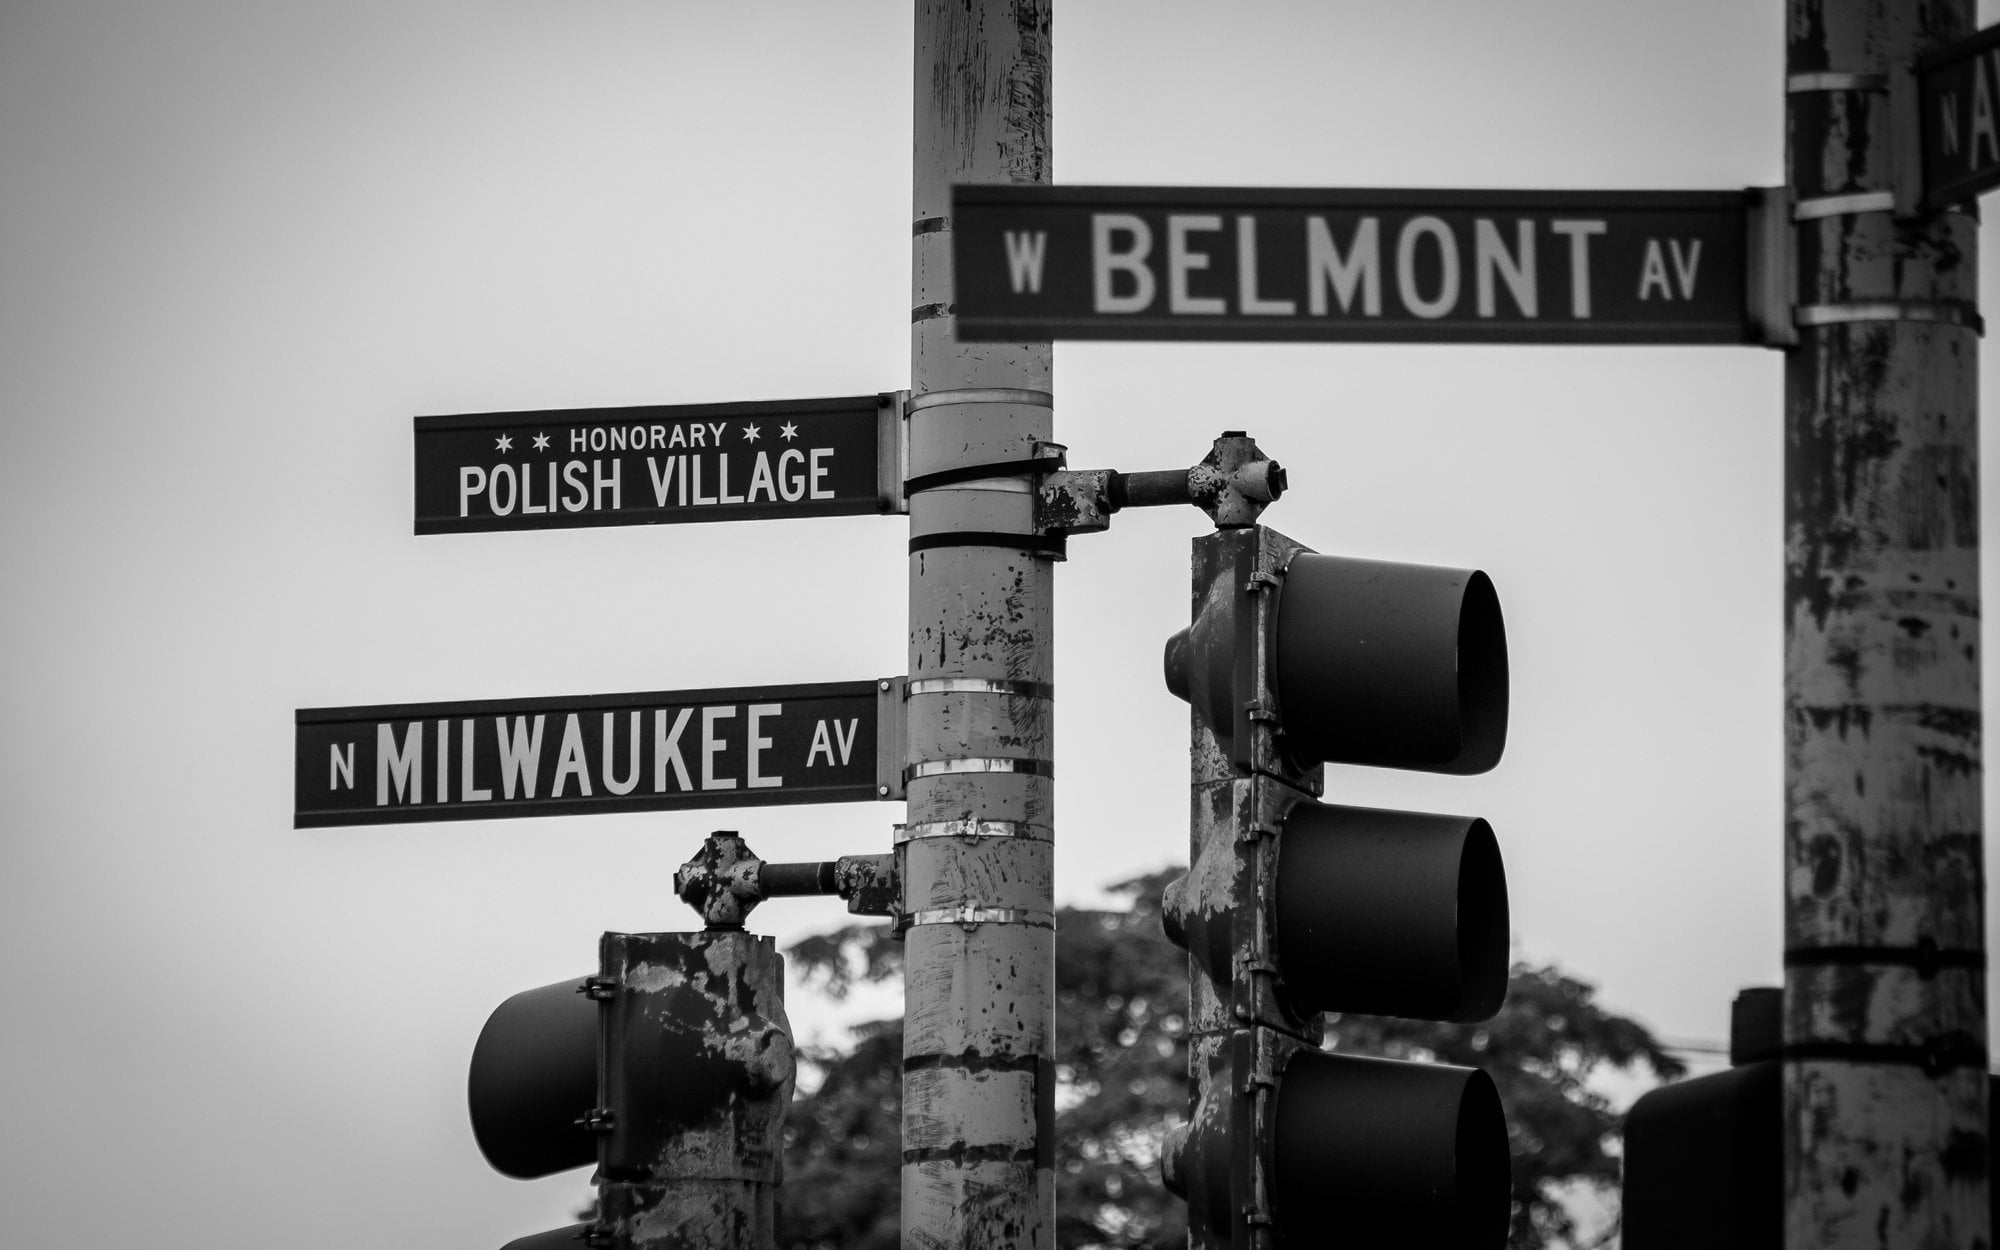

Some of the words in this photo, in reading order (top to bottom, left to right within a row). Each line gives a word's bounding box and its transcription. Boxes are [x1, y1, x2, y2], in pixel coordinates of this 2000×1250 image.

[1968, 48, 2000, 171] A
[1004, 230, 1046, 294] W
[1091, 212, 1606, 319] BELMONT
[1638, 238, 1702, 301] AV
[459, 458, 621, 517] POLISH
[646, 447, 835, 508] VILLAGE
[570, 422, 727, 452] HONORARY
[329, 742, 355, 790] N
[376, 703, 783, 806] MILWAUKEE
[806, 718, 860, 768] AV
